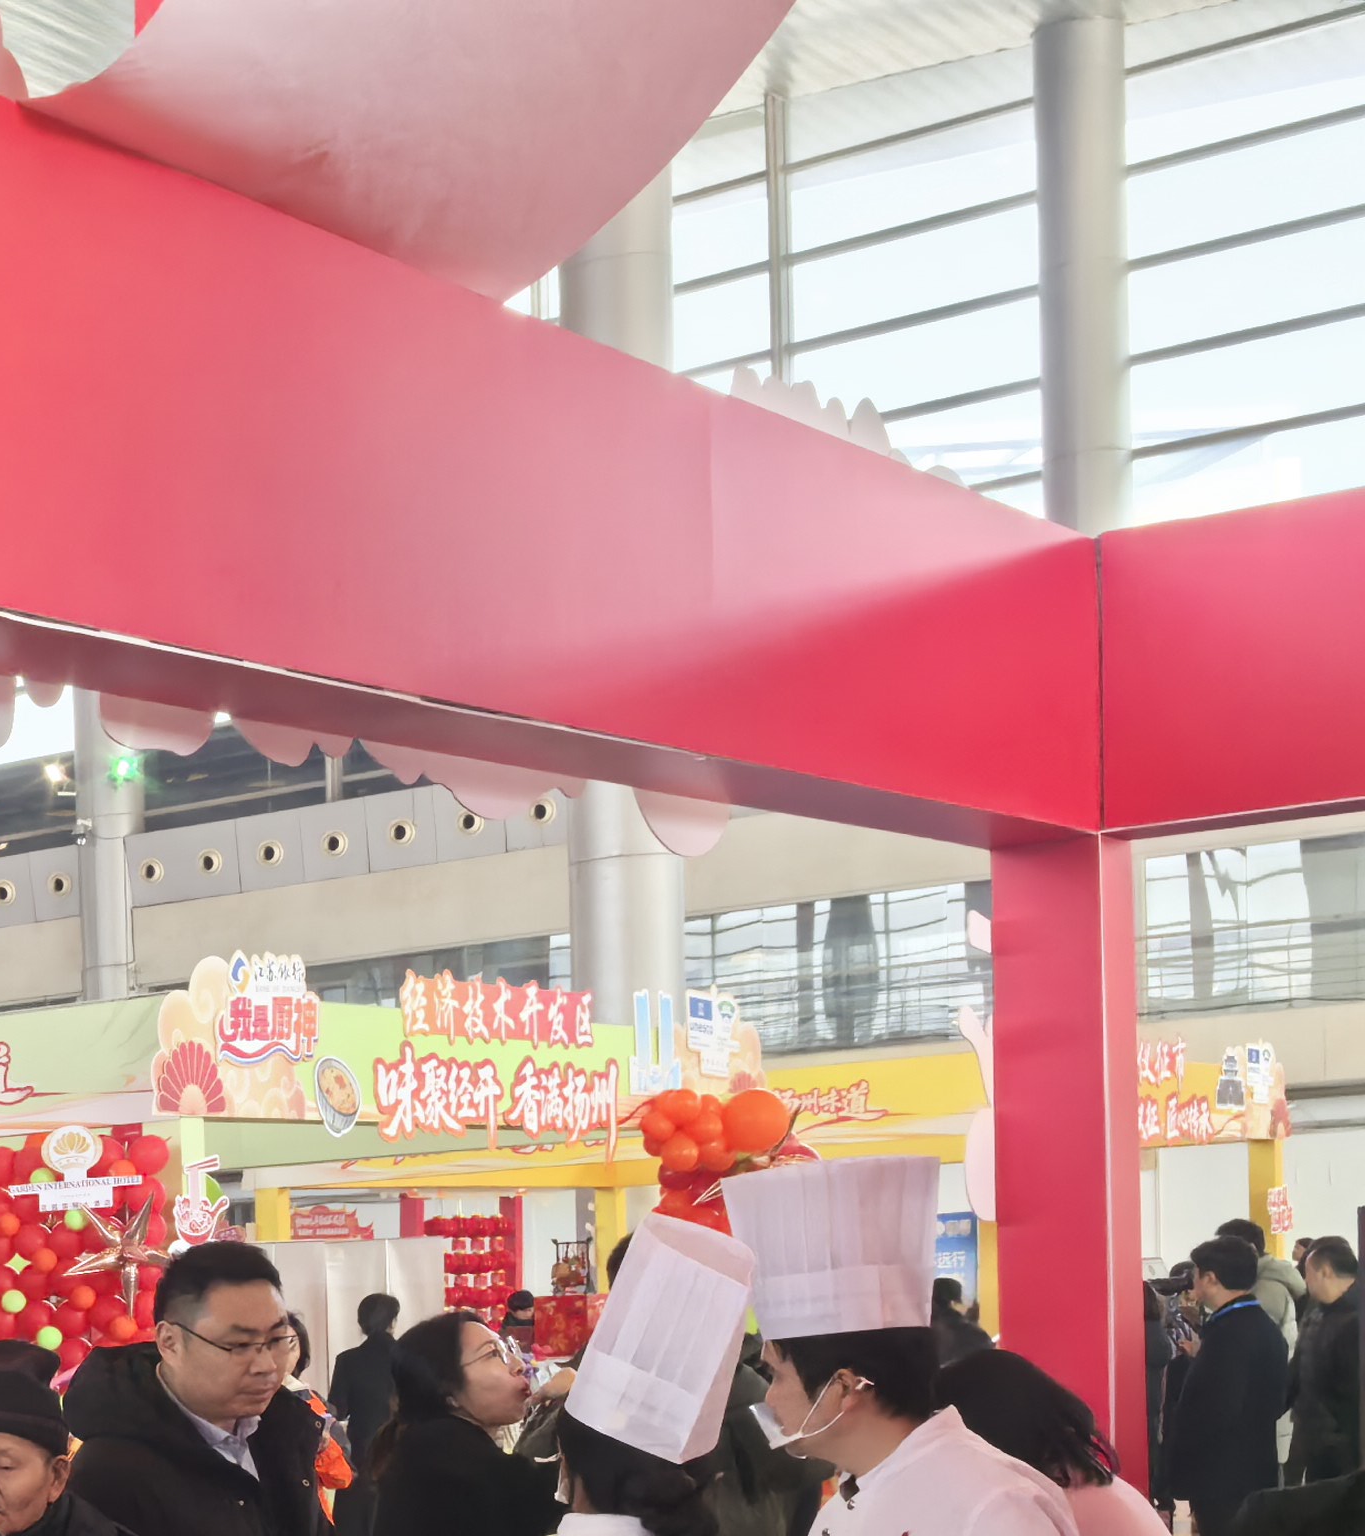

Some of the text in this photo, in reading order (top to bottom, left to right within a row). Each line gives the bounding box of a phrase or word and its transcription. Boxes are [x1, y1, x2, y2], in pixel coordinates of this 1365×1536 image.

[219, 996, 317, 1056] 我是厨神
[402, 971, 593, 1047] 经济技术开发区
[376, 1046, 619, 1164] 味聚经开 香满扬州
[10, 1176, 141, 1195] GARDEN INTERNATIONAL HOTEL
